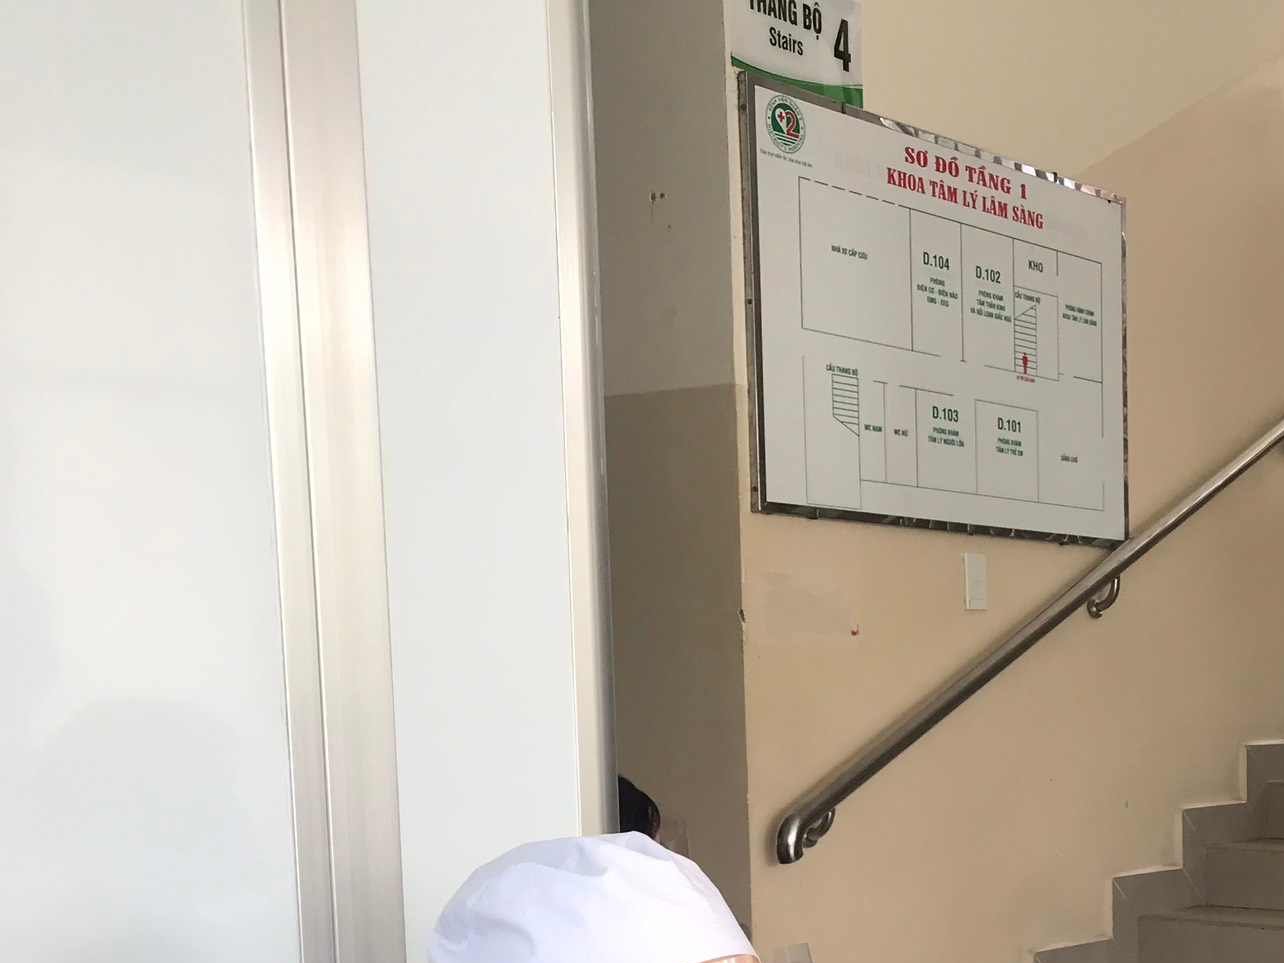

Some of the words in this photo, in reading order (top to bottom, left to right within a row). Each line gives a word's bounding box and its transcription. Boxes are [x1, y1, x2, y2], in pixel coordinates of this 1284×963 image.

[802, 2, 822, 40] BỘ
[769, 26, 804, 56] Stairs
[834, 19, 851, 72] 4
[904, 145, 929, 169] SƠ
[934, 154, 961, 179] ĐỒ
[965, 164, 1012, 195] TẦNG
[1019, 183, 1028, 200] 1
[886, 166, 926, 195] KHOA
[929, 178, 958, 205] TÂM
[962, 189, 979, 210] LÝ
[981, 193, 1009, 219] LÂM
[1012, 201, 1044, 230] SÀNG
[922, 251, 951, 271] D.104
[1028, 259, 1044, 274] KHO
[975, 265, 1002, 285] D.102
[932, 405, 959, 423] D.103
[998, 417, 1021, 433] D.101
